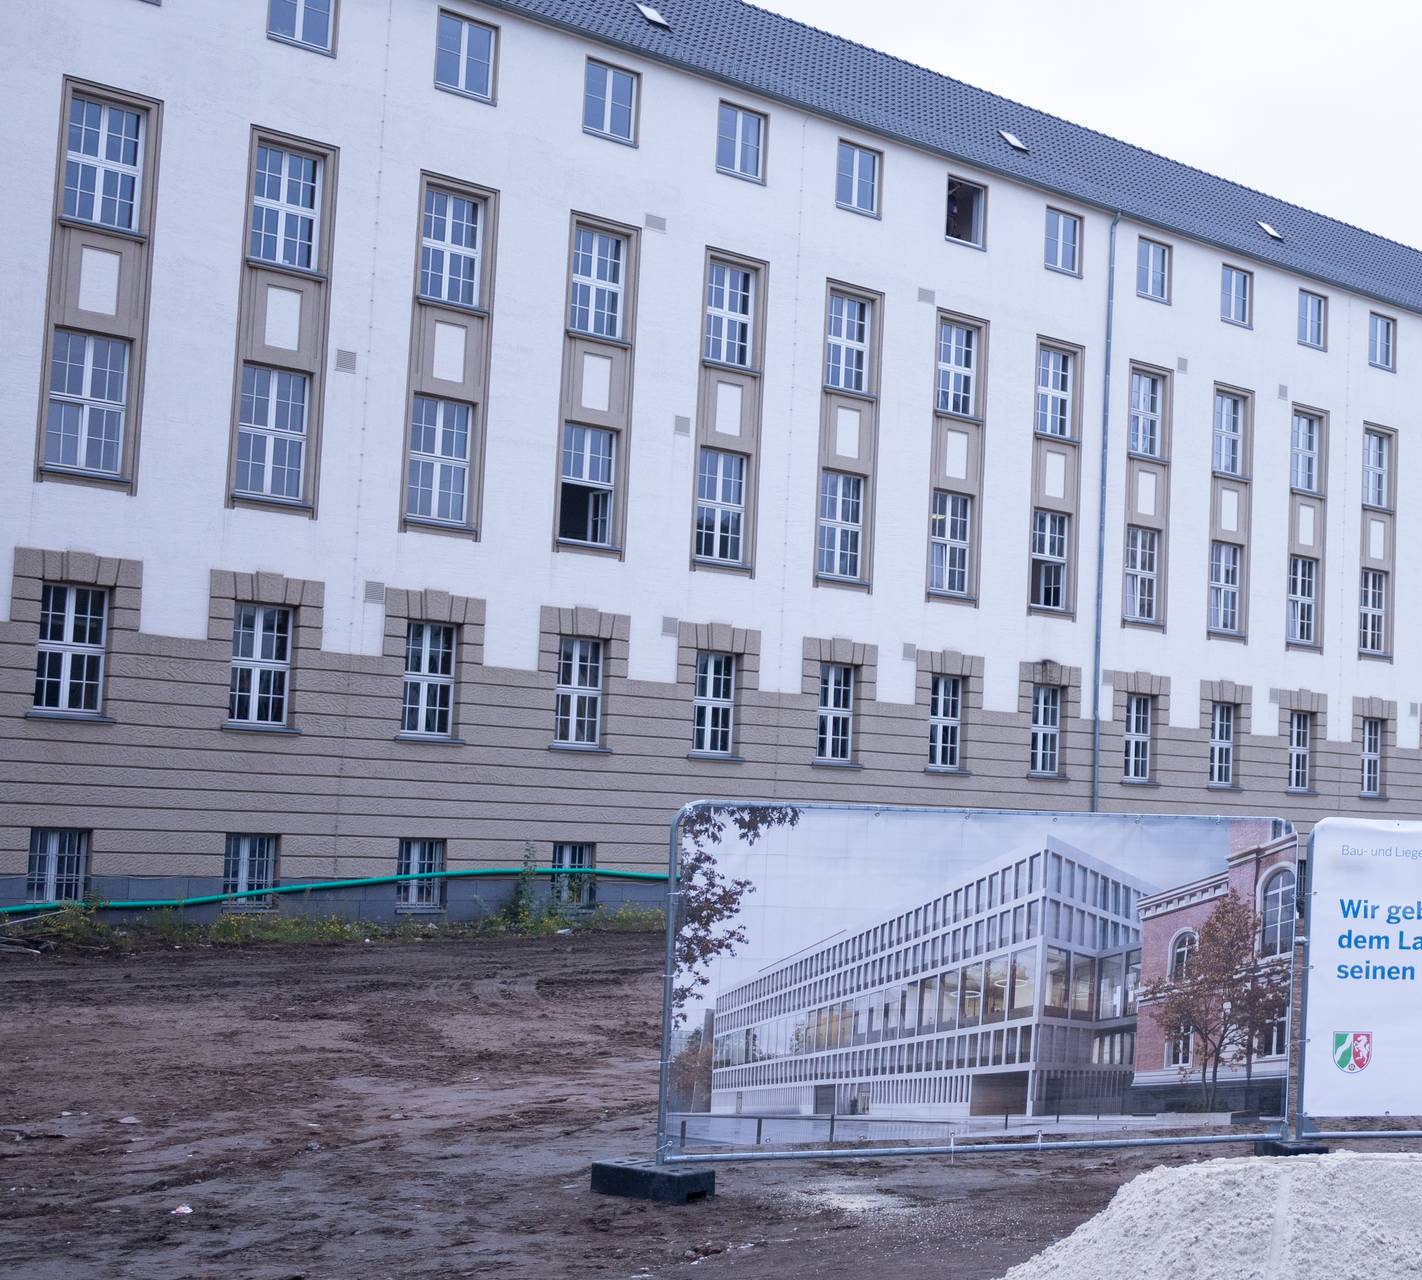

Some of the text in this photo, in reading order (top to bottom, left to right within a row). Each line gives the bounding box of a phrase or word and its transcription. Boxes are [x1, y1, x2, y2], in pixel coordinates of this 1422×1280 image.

[1341, 845, 1368, 856] Bau-
[1371, 846, 1392, 857] und
[1340, 899, 1380, 919] Wir
[1337, 929, 1390, 950] dem
[1336, 960, 1415, 981] seinen
